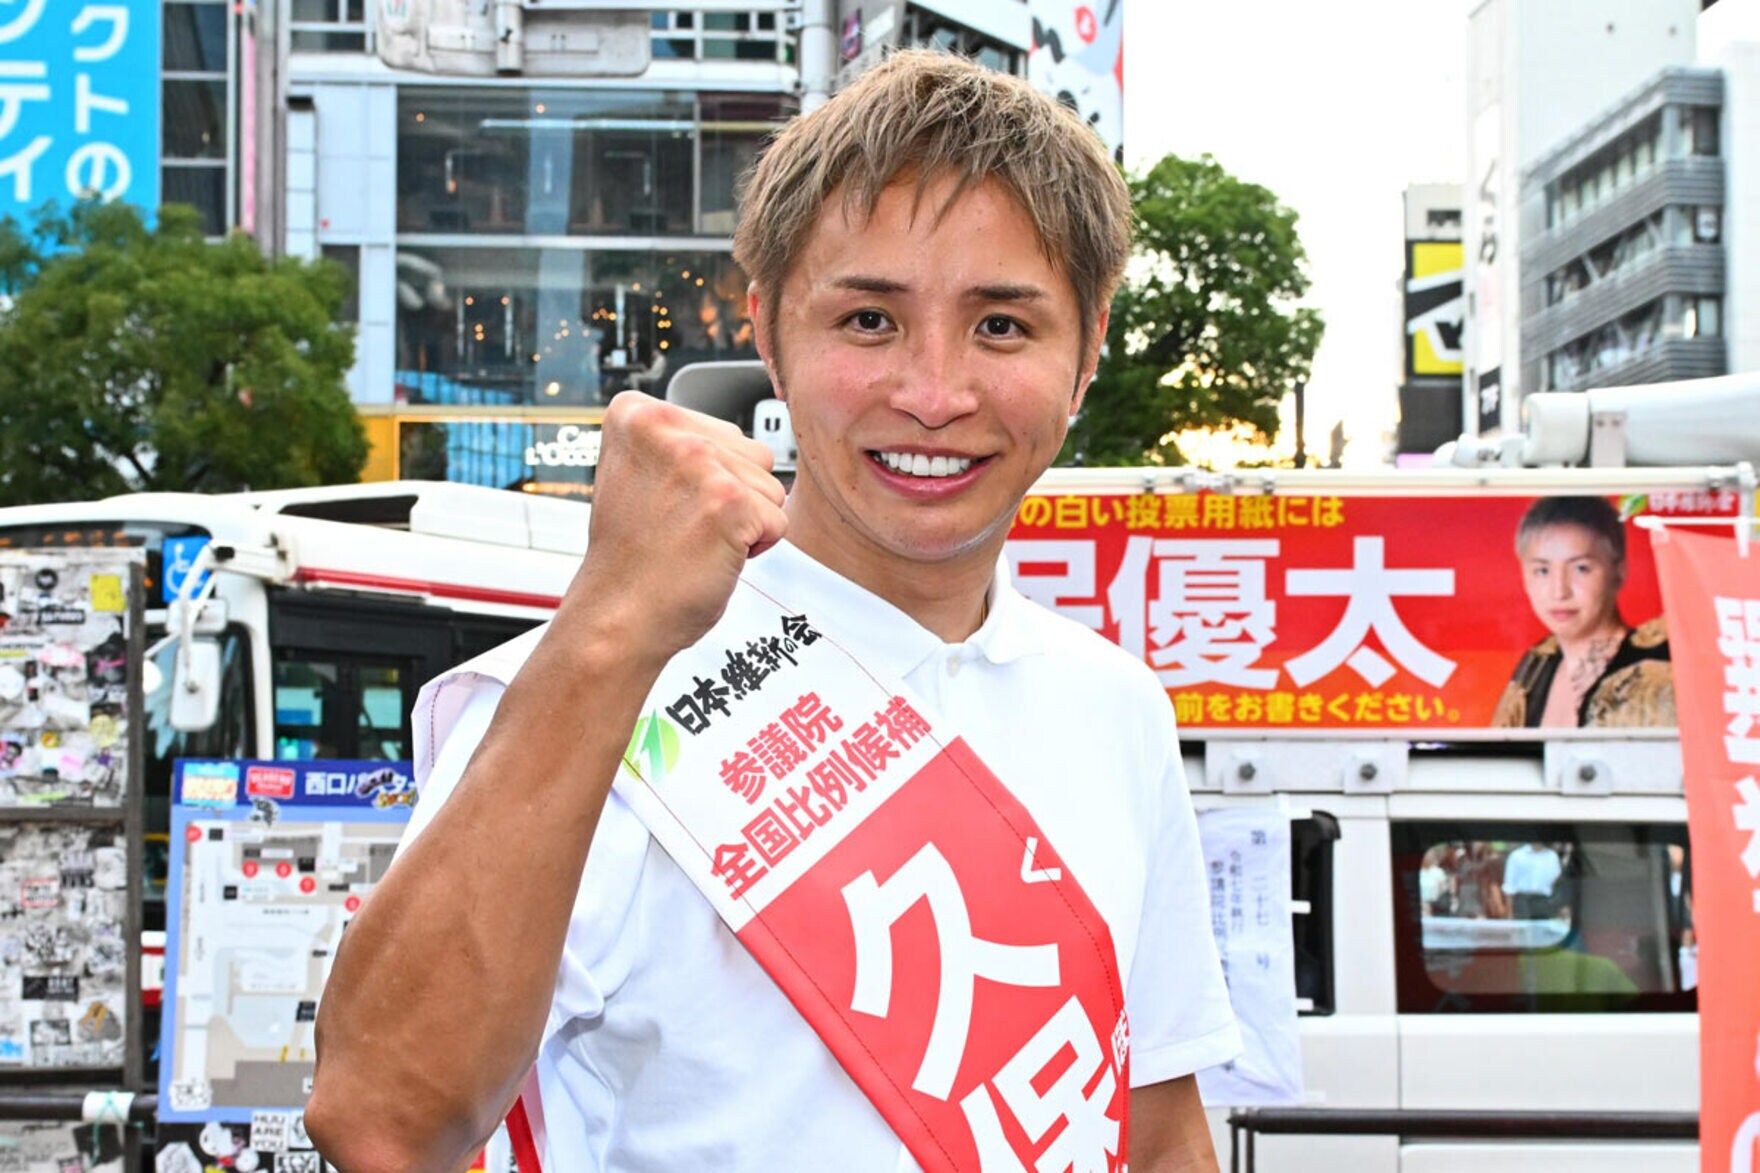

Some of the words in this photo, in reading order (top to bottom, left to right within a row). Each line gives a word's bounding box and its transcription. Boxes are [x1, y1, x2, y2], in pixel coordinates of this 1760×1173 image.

[1012, 496, 1345, 528] の白い投票用紙には
[665, 614, 822, 736] 日本維新の会
[710, 695, 932, 901] 全国比例候補
[719, 691, 844, 805] 参議院
